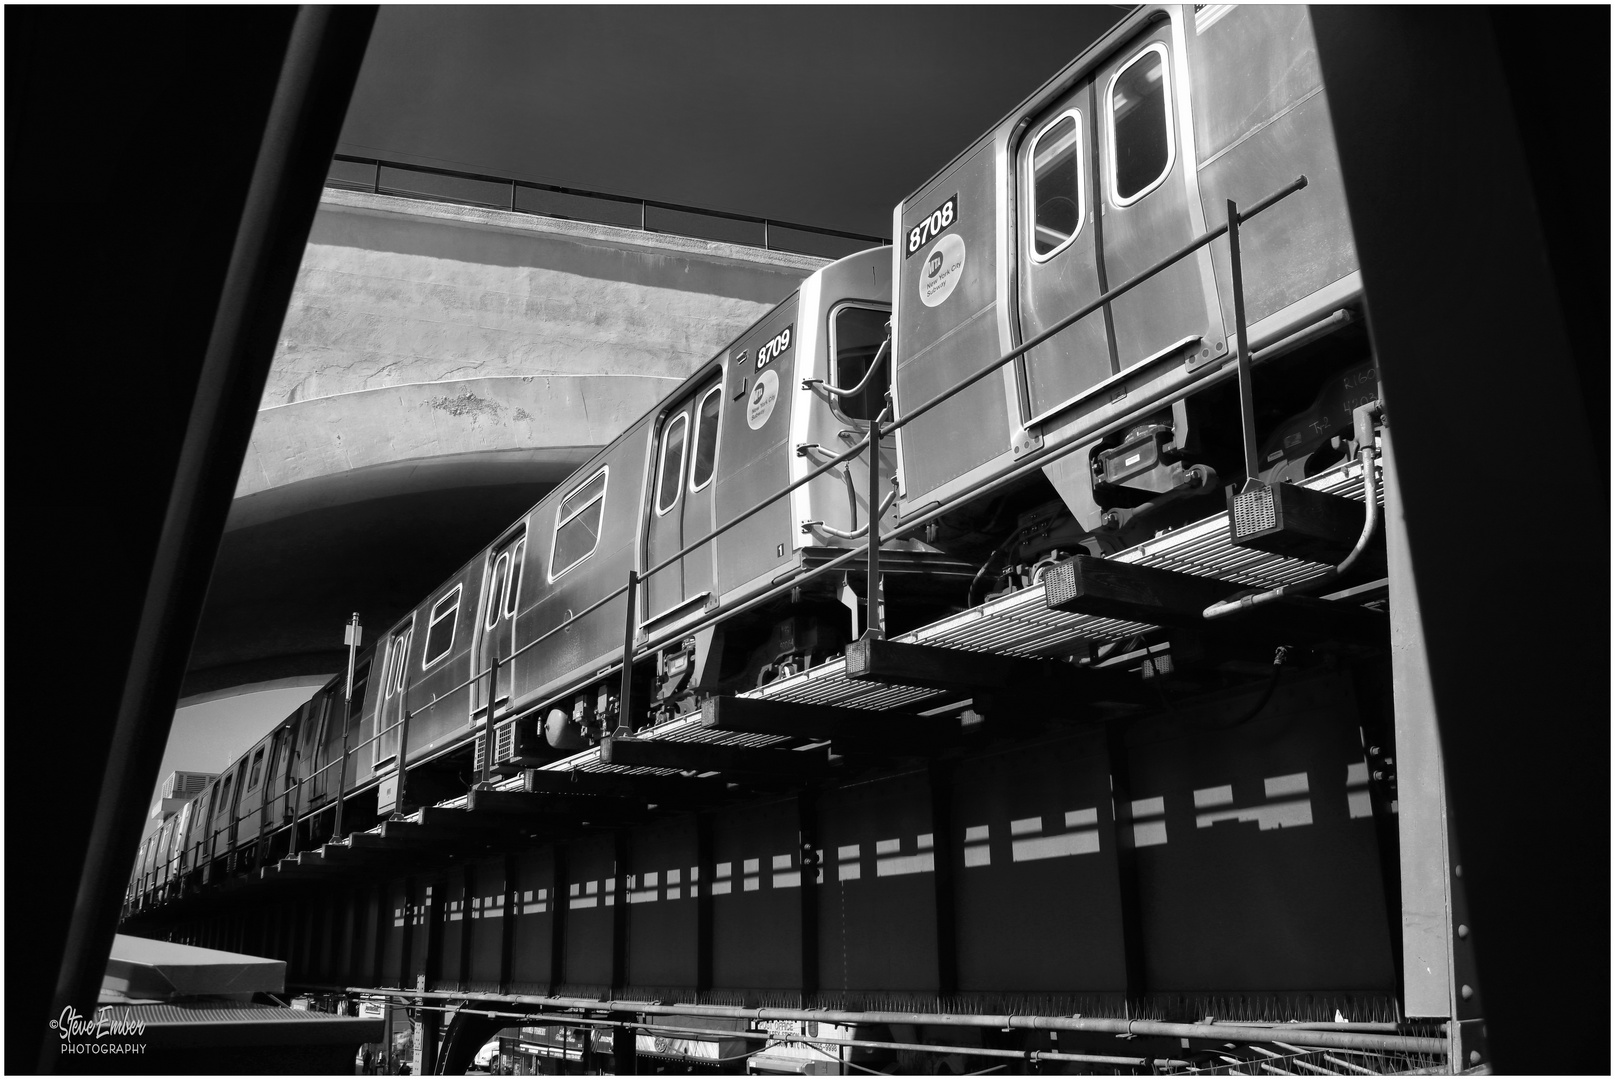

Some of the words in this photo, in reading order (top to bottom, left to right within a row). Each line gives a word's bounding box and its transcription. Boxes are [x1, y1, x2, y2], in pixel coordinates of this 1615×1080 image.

[909, 201, 953, 252] 8708
[926, 279, 938, 290] New
[938, 269, 951, 280] York
[951, 261, 962, 272] City
[926, 280, 947, 298] Subway
[757, 329, 790, 368] 8709
[1343, 368, 1376, 390] R160
[778, 545, 783, 556] 1
[774, 1020, 794, 1031] OFFICE
